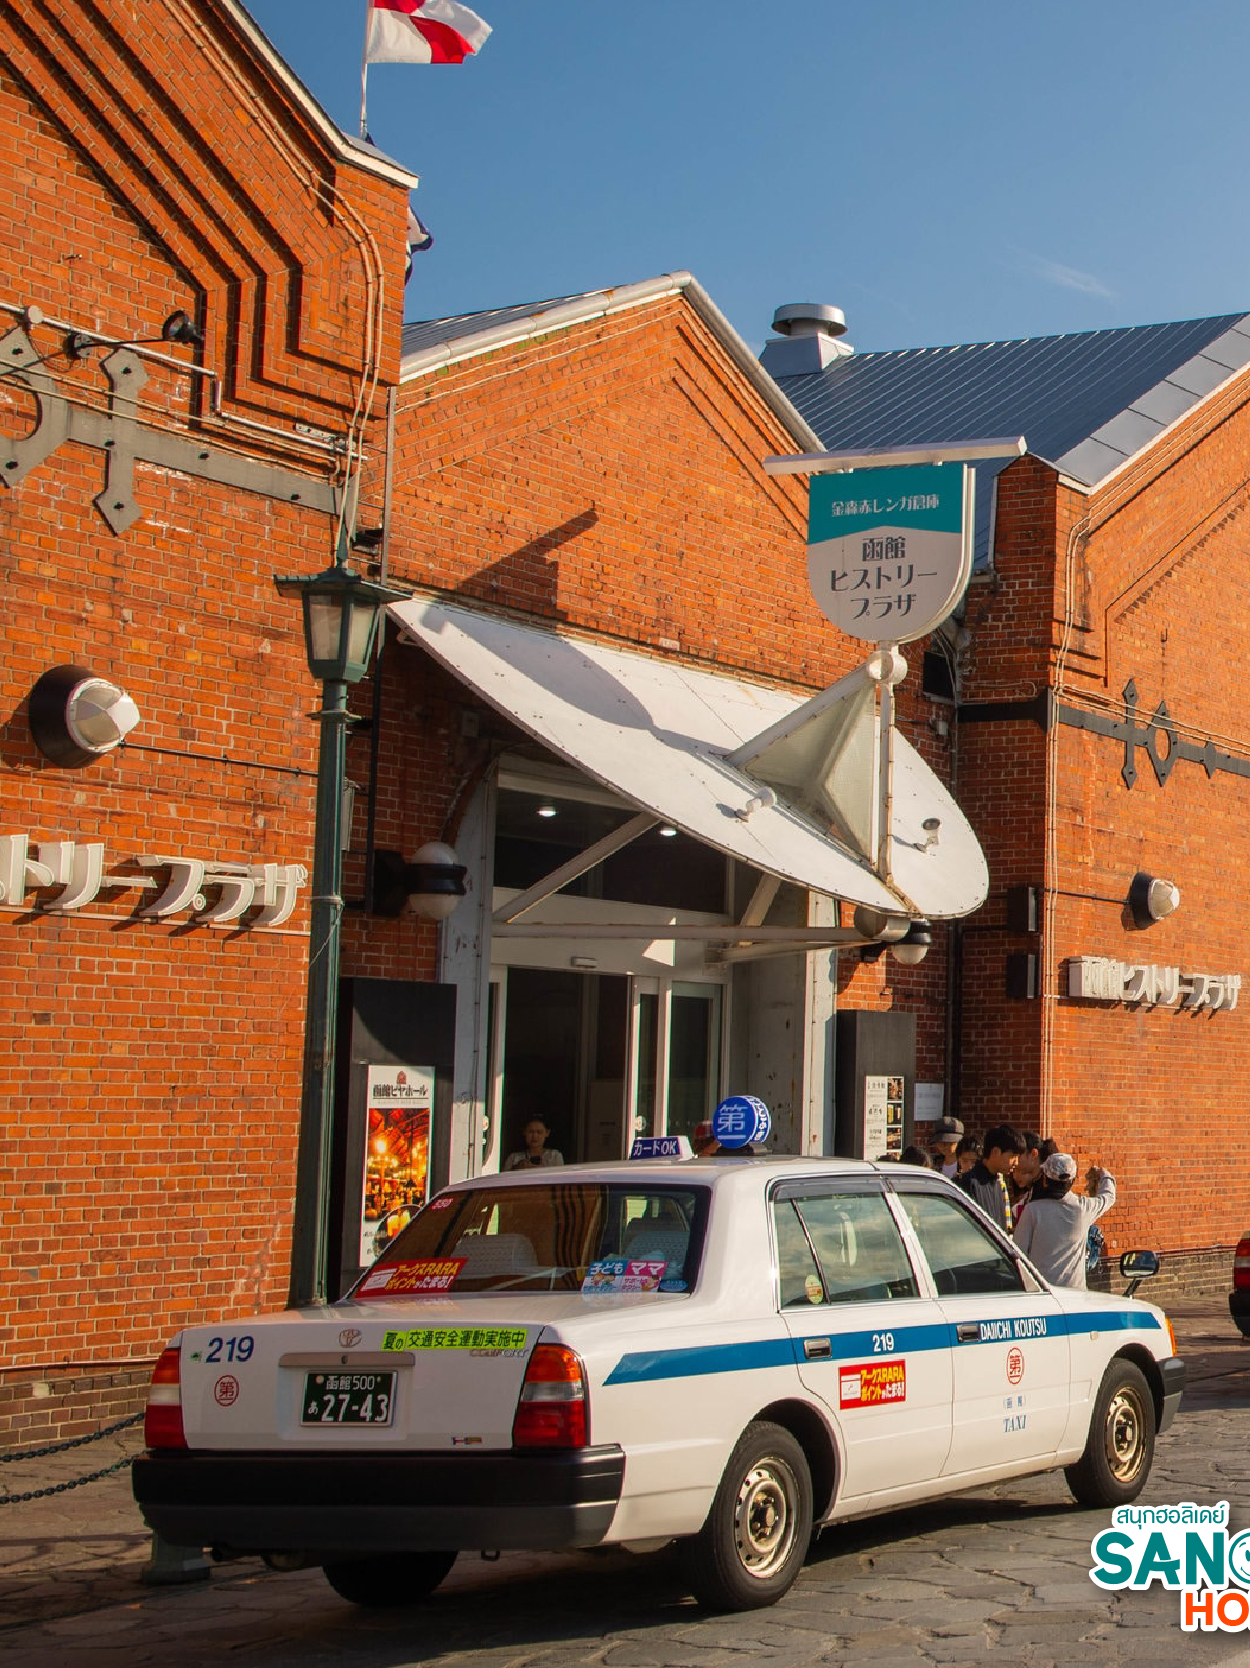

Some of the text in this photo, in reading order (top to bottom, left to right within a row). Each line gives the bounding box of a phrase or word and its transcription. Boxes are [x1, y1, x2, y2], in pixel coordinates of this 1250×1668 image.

[831, 494, 939, 517] 金森赤レンガ倉庫
[862, 536, 906, 562] 函館
[830, 564, 938, 592] ヒストリー
[850, 594, 917, 620] プラザ
[0, 834, 309, 926] トリープラザ
[633, 1140, 677, 1156] カードOK
[590, 1262, 624, 1275] 子ども
[631, 1262, 665, 1275] ママ
[980, 1317, 1047, 1340] DAIICHI KOUTSU
[206, 1336, 255, 1363] 219
[872, 1333, 895, 1352] 219
[308, 1393, 389, 1422] あ 27-43
[1002, 1414, 1027, 1433] TAXI
